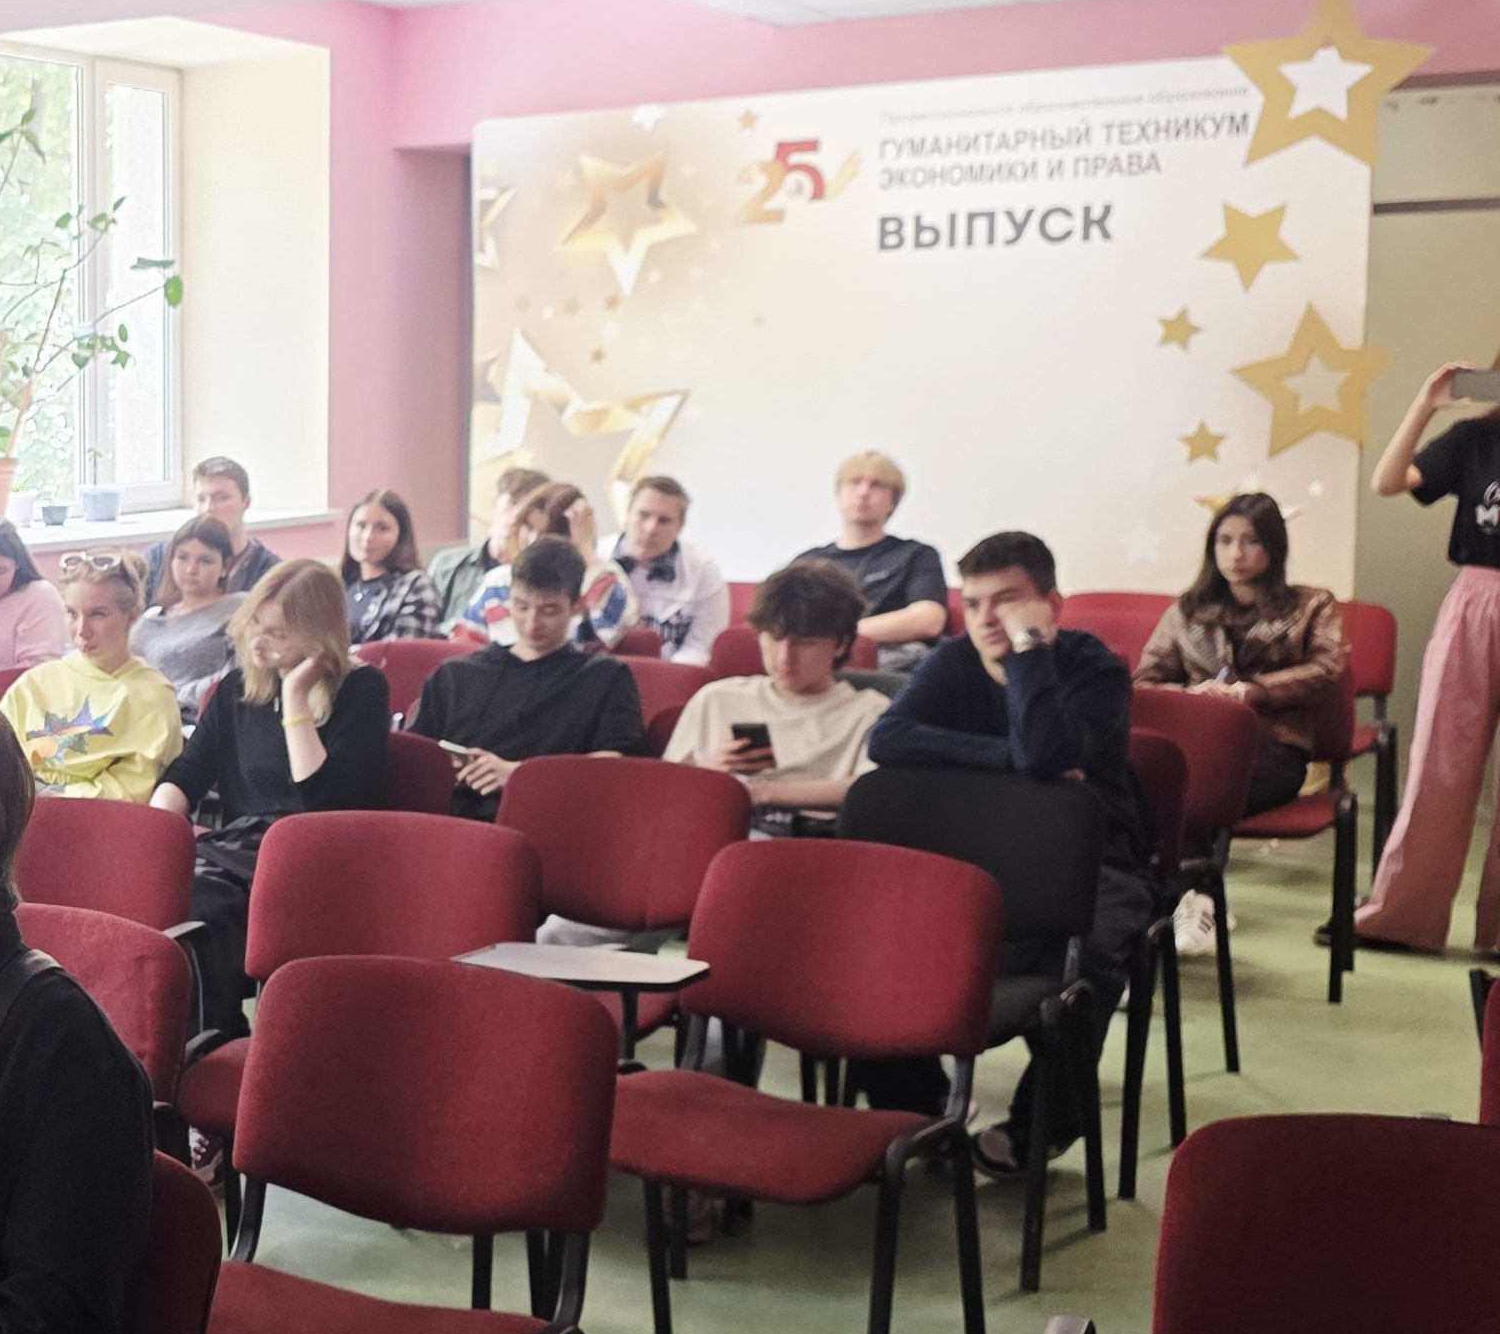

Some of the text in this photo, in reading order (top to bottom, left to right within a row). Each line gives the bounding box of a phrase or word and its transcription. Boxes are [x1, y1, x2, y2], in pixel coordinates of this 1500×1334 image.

[878, 113, 1250, 159] ГУМАНИТАРНЫЙ ТЕХНИКУМ
[878, 152, 1161, 191] ЭКОНОМИКИ И ПРАВА
[878, 204, 1113, 250] ВЫПУСК
